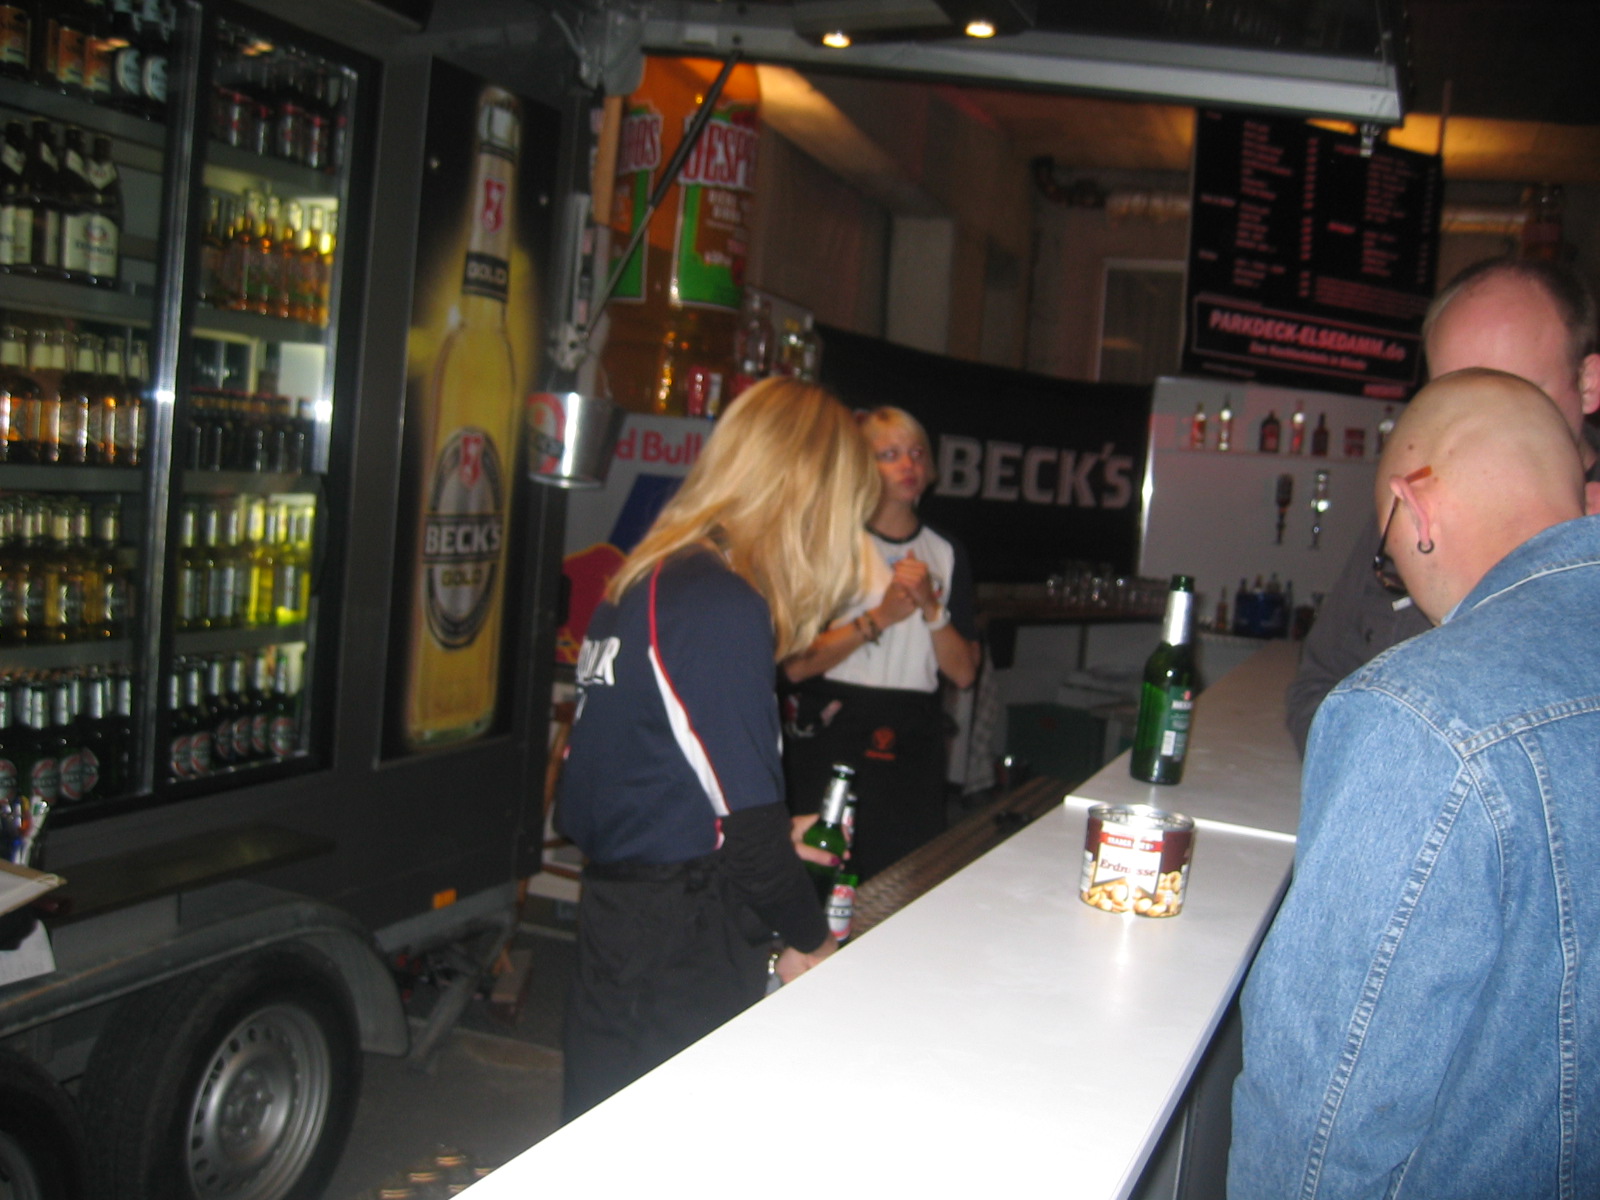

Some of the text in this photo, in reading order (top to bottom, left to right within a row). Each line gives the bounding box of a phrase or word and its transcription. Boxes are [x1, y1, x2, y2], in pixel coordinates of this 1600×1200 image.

[641, 430, 703, 466] Bull
[935, 433, 1133, 510] BECK'S
[424, 520, 501, 555] BECK'S
